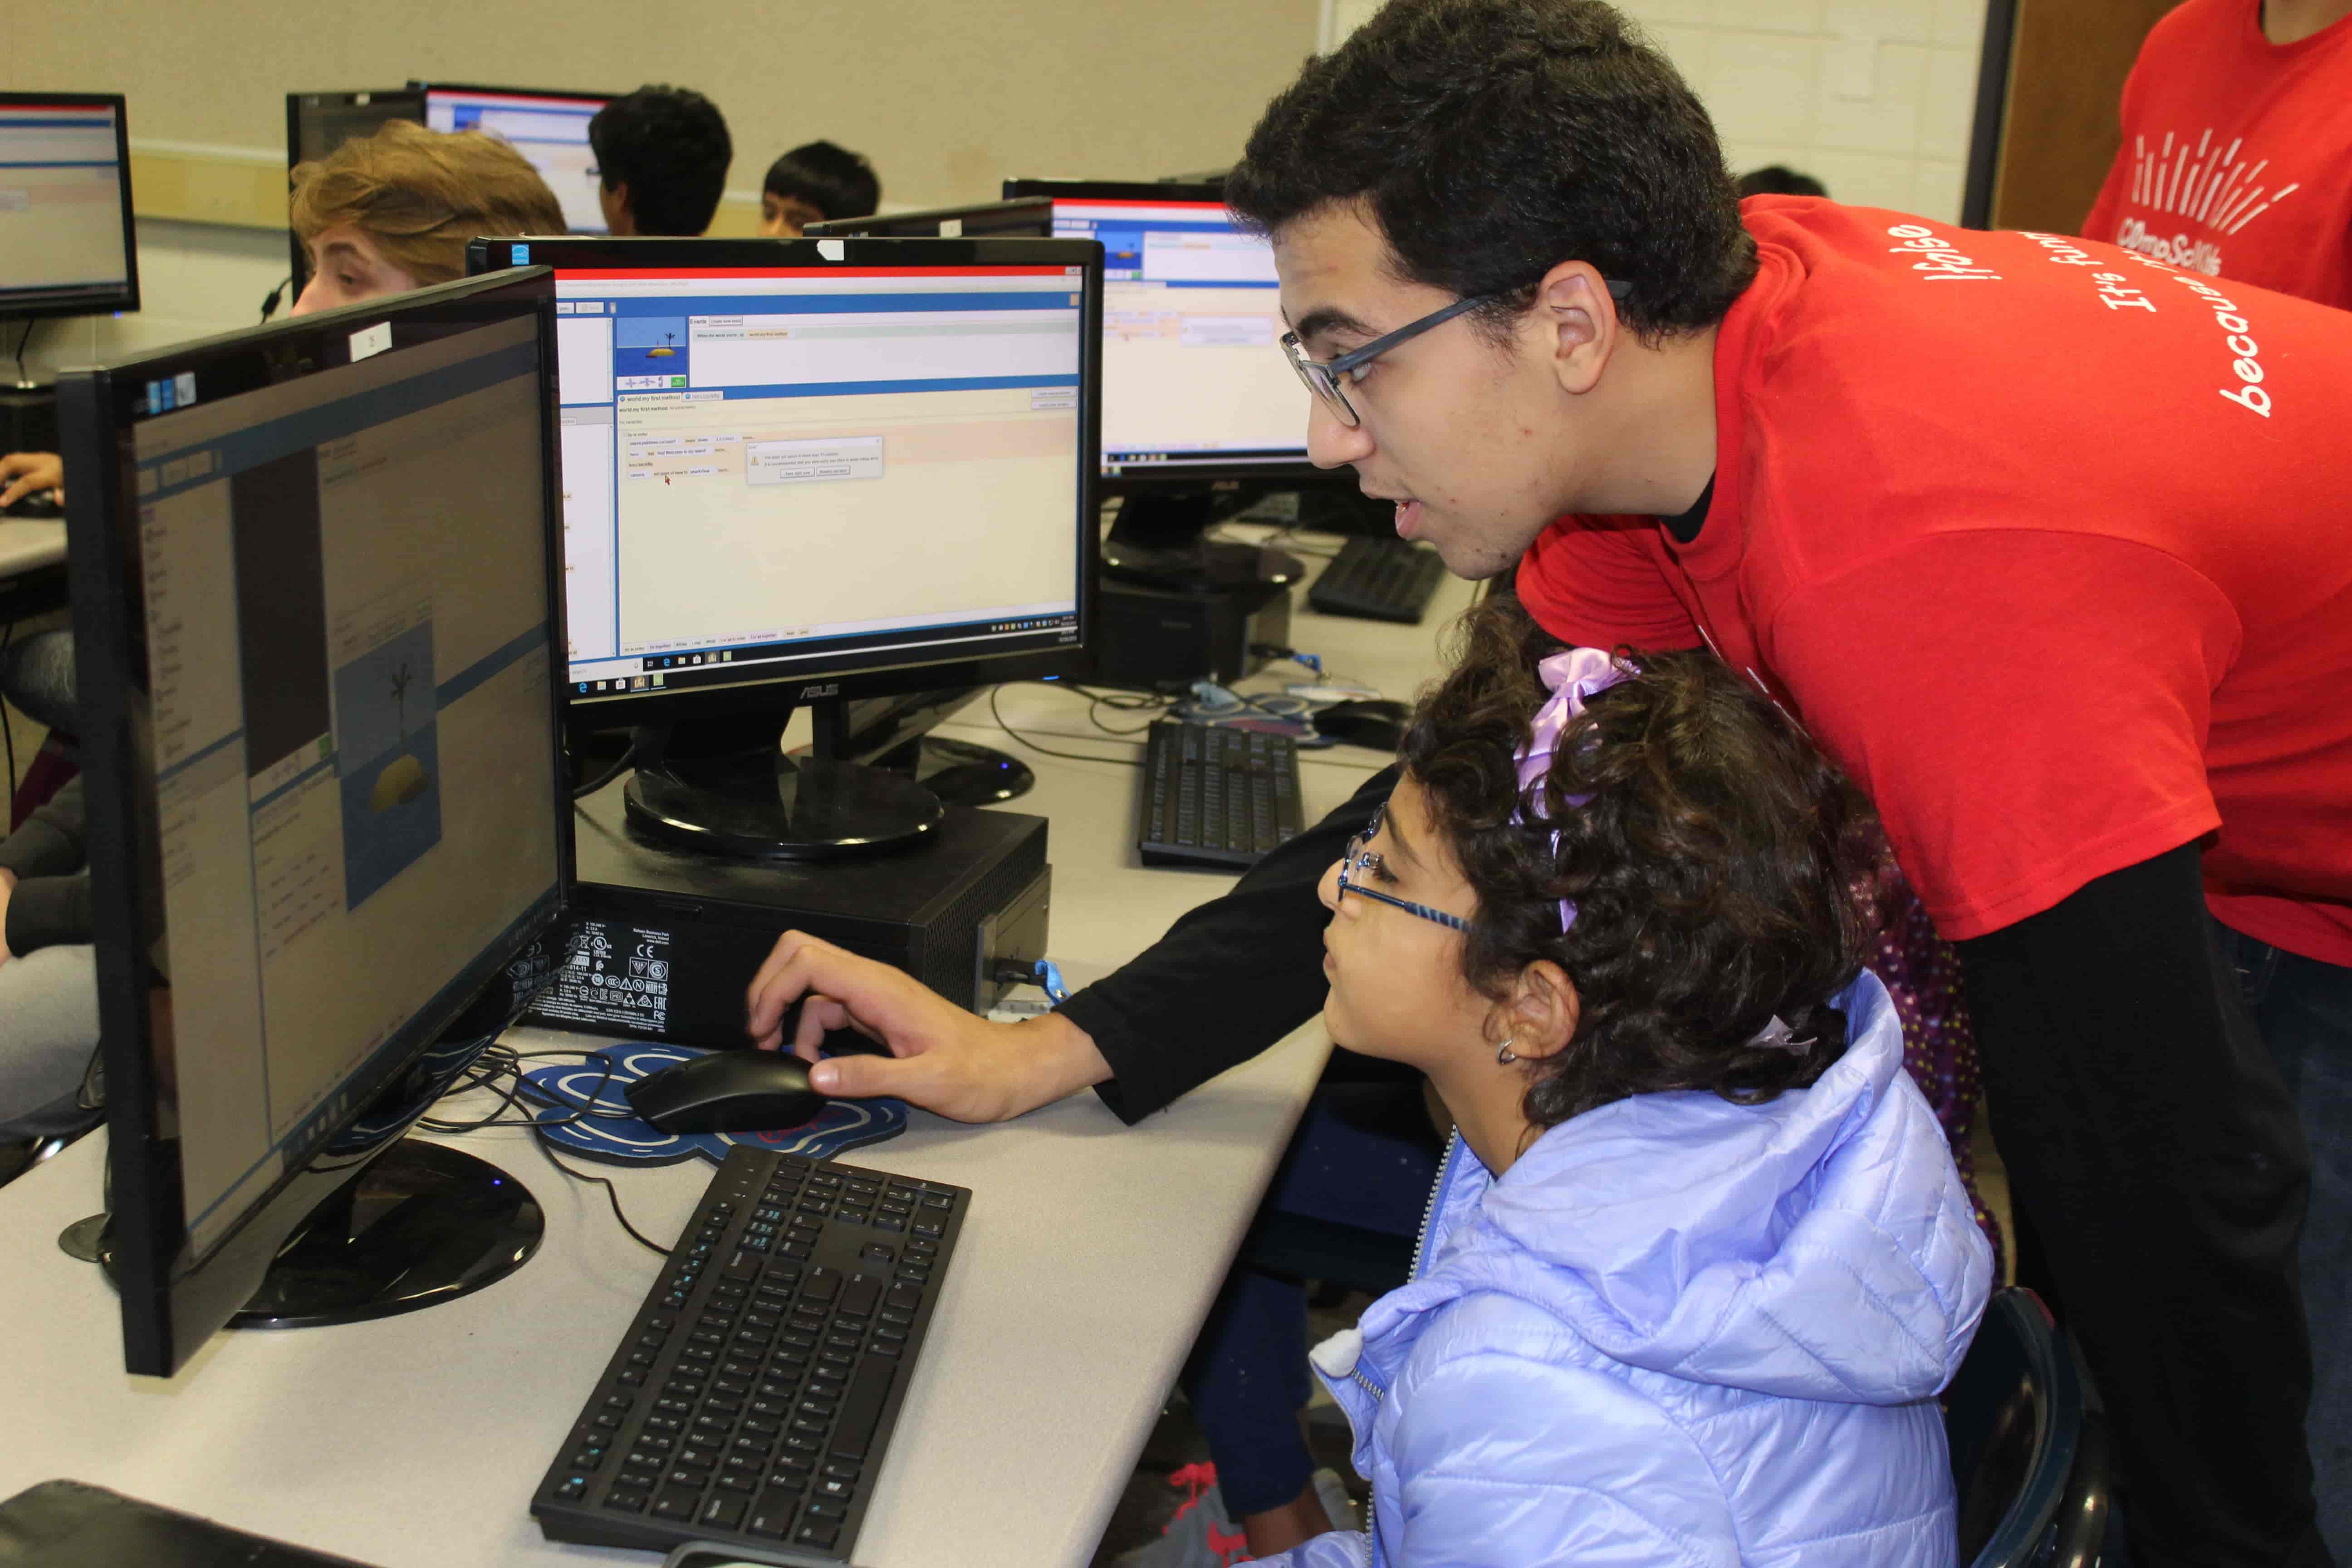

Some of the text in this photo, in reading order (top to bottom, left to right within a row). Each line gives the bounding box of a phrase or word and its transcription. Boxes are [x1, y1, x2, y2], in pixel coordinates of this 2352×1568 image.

[2018, 231, 2156, 312] It's funn
[2173, 276, 2271, 417] because
[799, 683, 839, 699] ASUS
